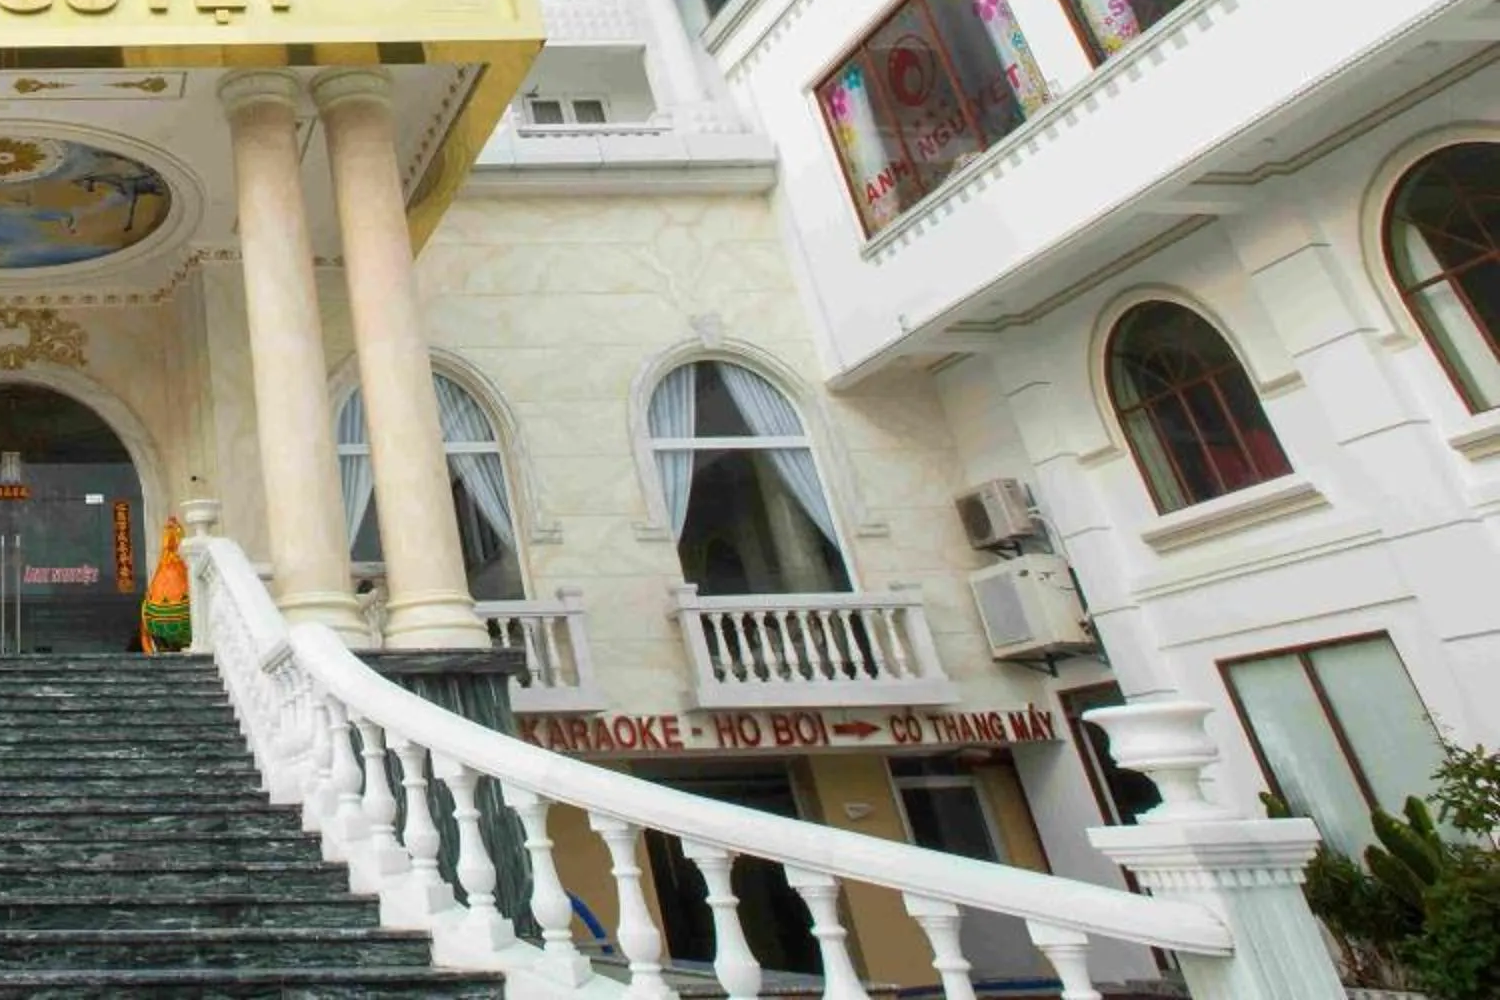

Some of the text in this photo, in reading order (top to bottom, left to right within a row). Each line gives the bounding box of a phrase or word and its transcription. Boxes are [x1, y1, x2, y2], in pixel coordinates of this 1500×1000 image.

[518, 714, 685, 752] KARAOKE
[927, 711, 1008, 743] THANG
[1008, 702, 1056, 742] MÁY
